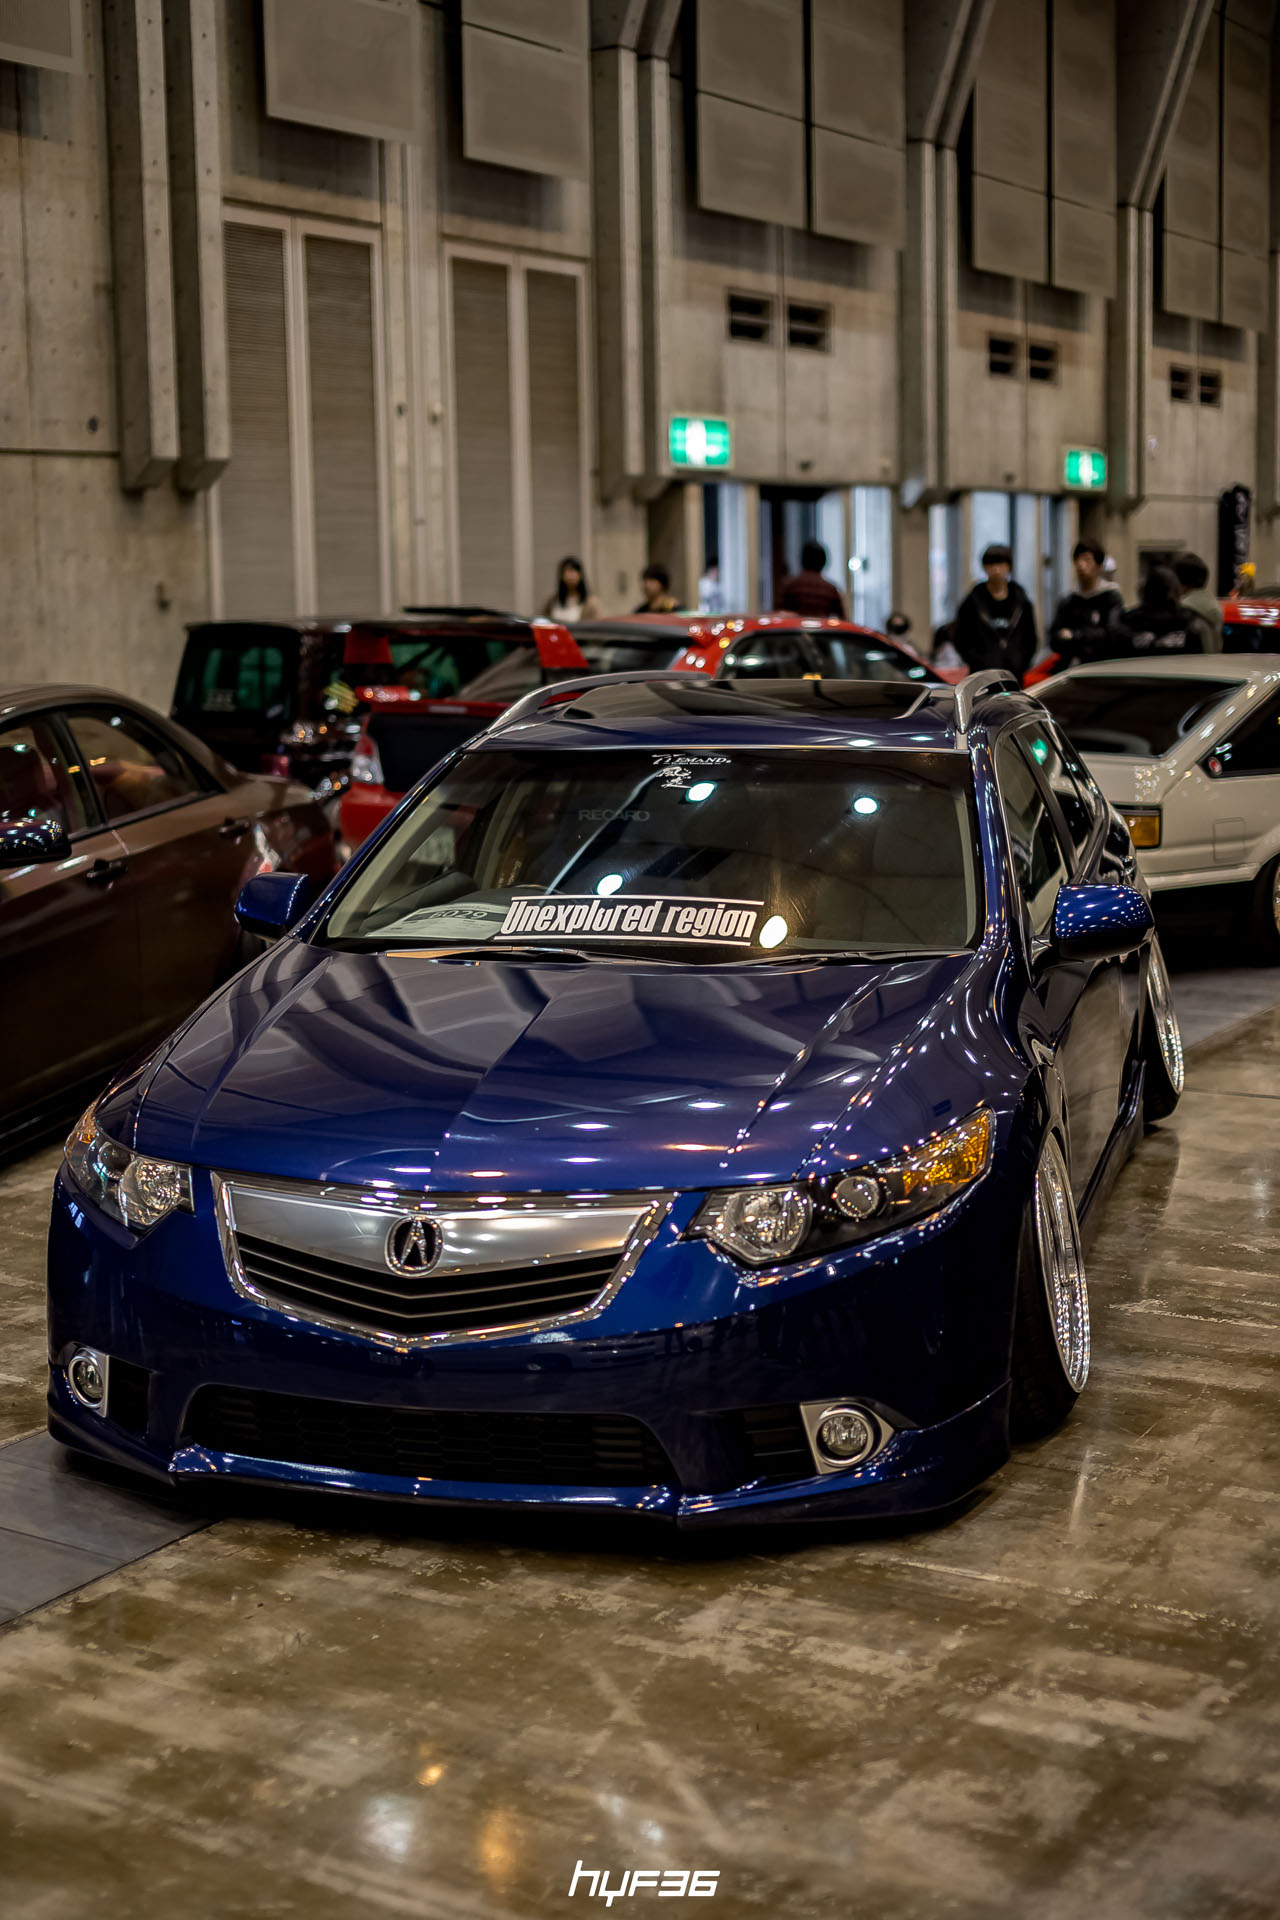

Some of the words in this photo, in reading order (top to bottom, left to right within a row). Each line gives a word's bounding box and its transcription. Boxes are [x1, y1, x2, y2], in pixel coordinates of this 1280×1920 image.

[577, 808, 650, 822] RECARO
[501, 899, 663, 934] Unexplored
[661, 903, 758, 939] region
